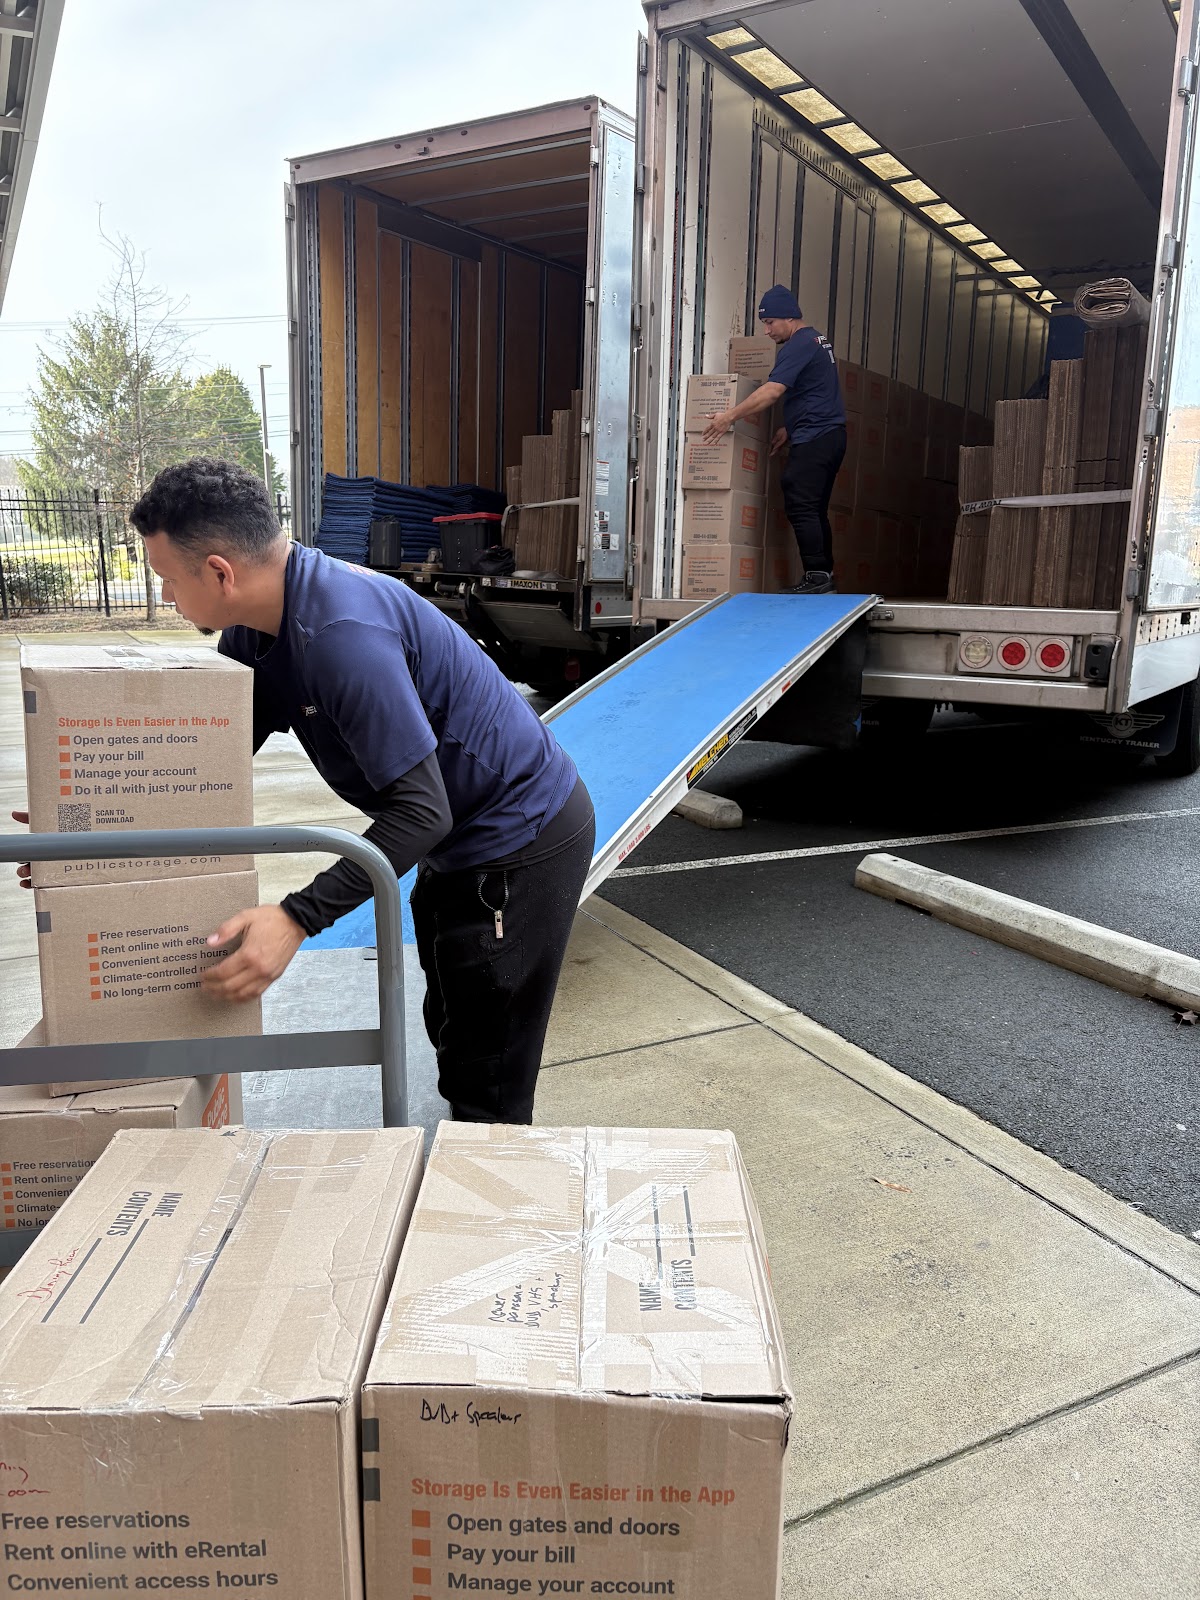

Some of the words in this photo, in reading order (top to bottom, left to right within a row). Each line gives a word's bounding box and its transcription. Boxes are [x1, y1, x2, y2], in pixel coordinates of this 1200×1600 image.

[514, 580, 538, 588] MAXON
[58, 717, 100, 728] Storage
[103, 717, 114, 728] Is
[116, 717, 141, 728] Even
[144, 716, 176, 727] Easier
[179, 716, 189, 726] in
[192, 716, 208, 727] the
[210, 716, 230, 728] App
[74, 735, 104, 746] Open
[107, 735, 140, 746] gates
[142, 734, 164, 744] and
[166, 734, 198, 744] doors
[1080, 736, 1124, 744] KENTUCKY
[1125, 739, 1160, 748] TRAILER
[74, 752, 96, 764] Pay
[98, 753, 124, 763] your
[128, 750, 144, 761] bill
[74, 768, 122, 780] Manage
[124, 770, 150, 780] your
[152, 767, 197, 776] account
[75, 786, 91, 795] Do
[94, 785, 102, 794] it
[105, 784, 119, 794] all
[122, 784, 146, 794] with
[148, 783, 170, 795] just
[172, 784, 198, 794] your
[200, 781, 233, 793] phone
[96, 816, 134, 824] DOWNLOAD
[64, 855, 222, 872] publicstorage.com
[100, 931, 124, 940] Free
[126, 924, 189, 938] reservations
[101, 944, 125, 955] Rent
[128, 941, 160, 952] online
[162, 938, 183, 949] with
[102, 955, 160, 970] Convenient
[162, 952, 198, 963] access
[200, 950, 228, 958] hours
[102, 966, 198, 984] Climate-controlled
[104, 989, 118, 998] No
[121, 984, 172, 998] long-term
[13, 1161, 36, 1170] Free
[38, 1160, 97, 1169] reservation
[14, 1176, 38, 1184] Rent
[41, 1174, 73, 1184] online
[16, 1188, 74, 1198] Convenient
[106, 1190, 152, 1236] CONTENTS
[152, 1192, 184, 1218] NAME
[18, 1218, 33, 1228] No
[671, 1258, 697, 1311] CONTENTS
[640, 1280, 662, 1312] NAME
[412, 1478, 487, 1499] Storage
[493, 1480, 510, 1497] Is
[516, 1481, 562, 1500] Even
[570, 1483, 630, 1502] Easier
[636, 1484, 654, 1502] in
[659, 1486, 692, 1503] the
[697, 1487, 736, 1506] App
[1, 1512, 50, 1530] Free
[56, 1510, 190, 1528] reservations
[447, 1513, 502, 1535] Open
[509, 1516, 567, 1537] gates
[574, 1516, 614, 1534] and
[619, 1516, 680, 1536] doors
[4, 1543, 55, 1562] Rent
[61, 1542, 126, 1560] online
[133, 1542, 178, 1560] with
[184, 1539, 267, 1558] eRental
[447, 1544, 486, 1566] Pay
[492, 1548, 539, 1566] your
[544, 1545, 576, 1564] bill
[7, 1572, 129, 1591] Convenient
[135, 1573, 210, 1589] access
[216, 1570, 278, 1588] hours
[448, 1573, 532, 1595] Manage
[538, 1578, 584, 1596] your
[590, 1577, 675, 1596] account
